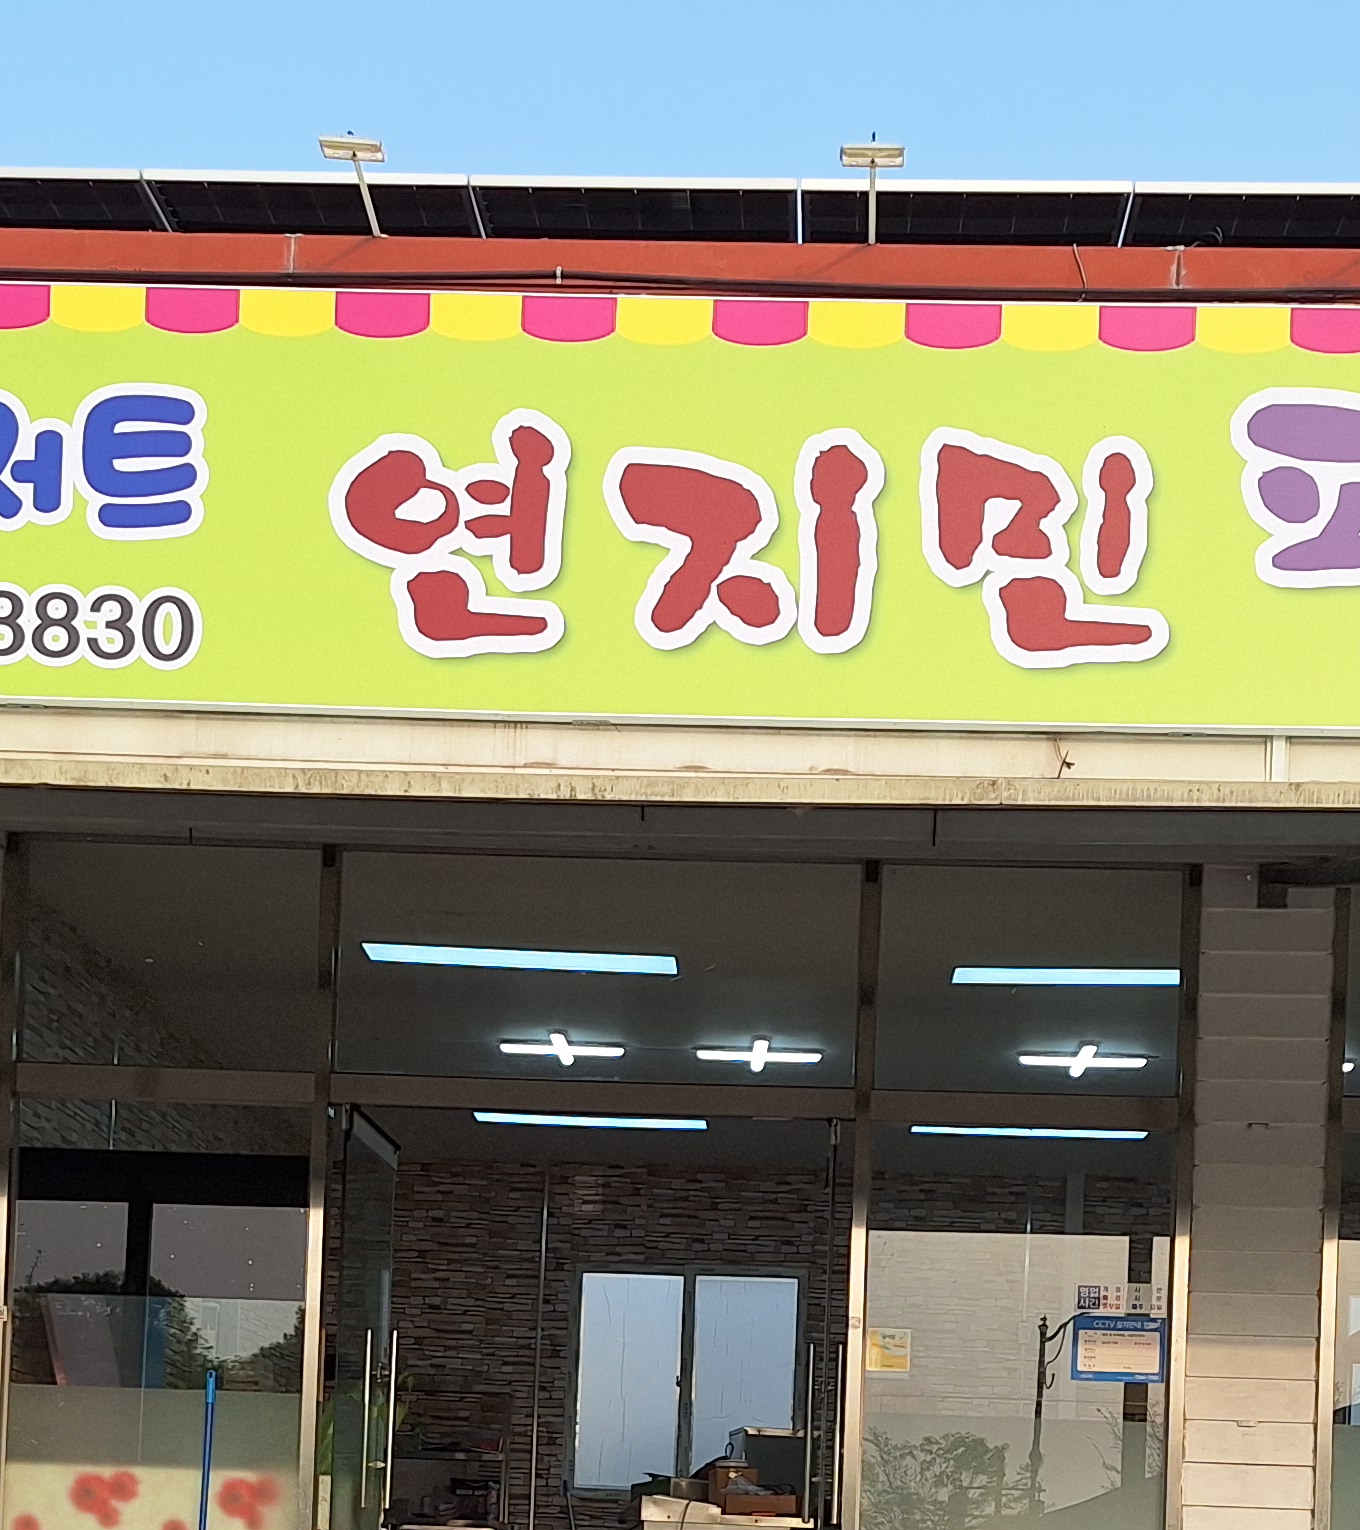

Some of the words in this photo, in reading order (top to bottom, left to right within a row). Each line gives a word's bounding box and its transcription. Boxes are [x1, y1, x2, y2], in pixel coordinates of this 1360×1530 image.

[1079, 1286, 1099, 1297] 영업
[1079, 1297, 1099, 1308] 시간
[1093, 1320, 1115, 1328] CCTV
